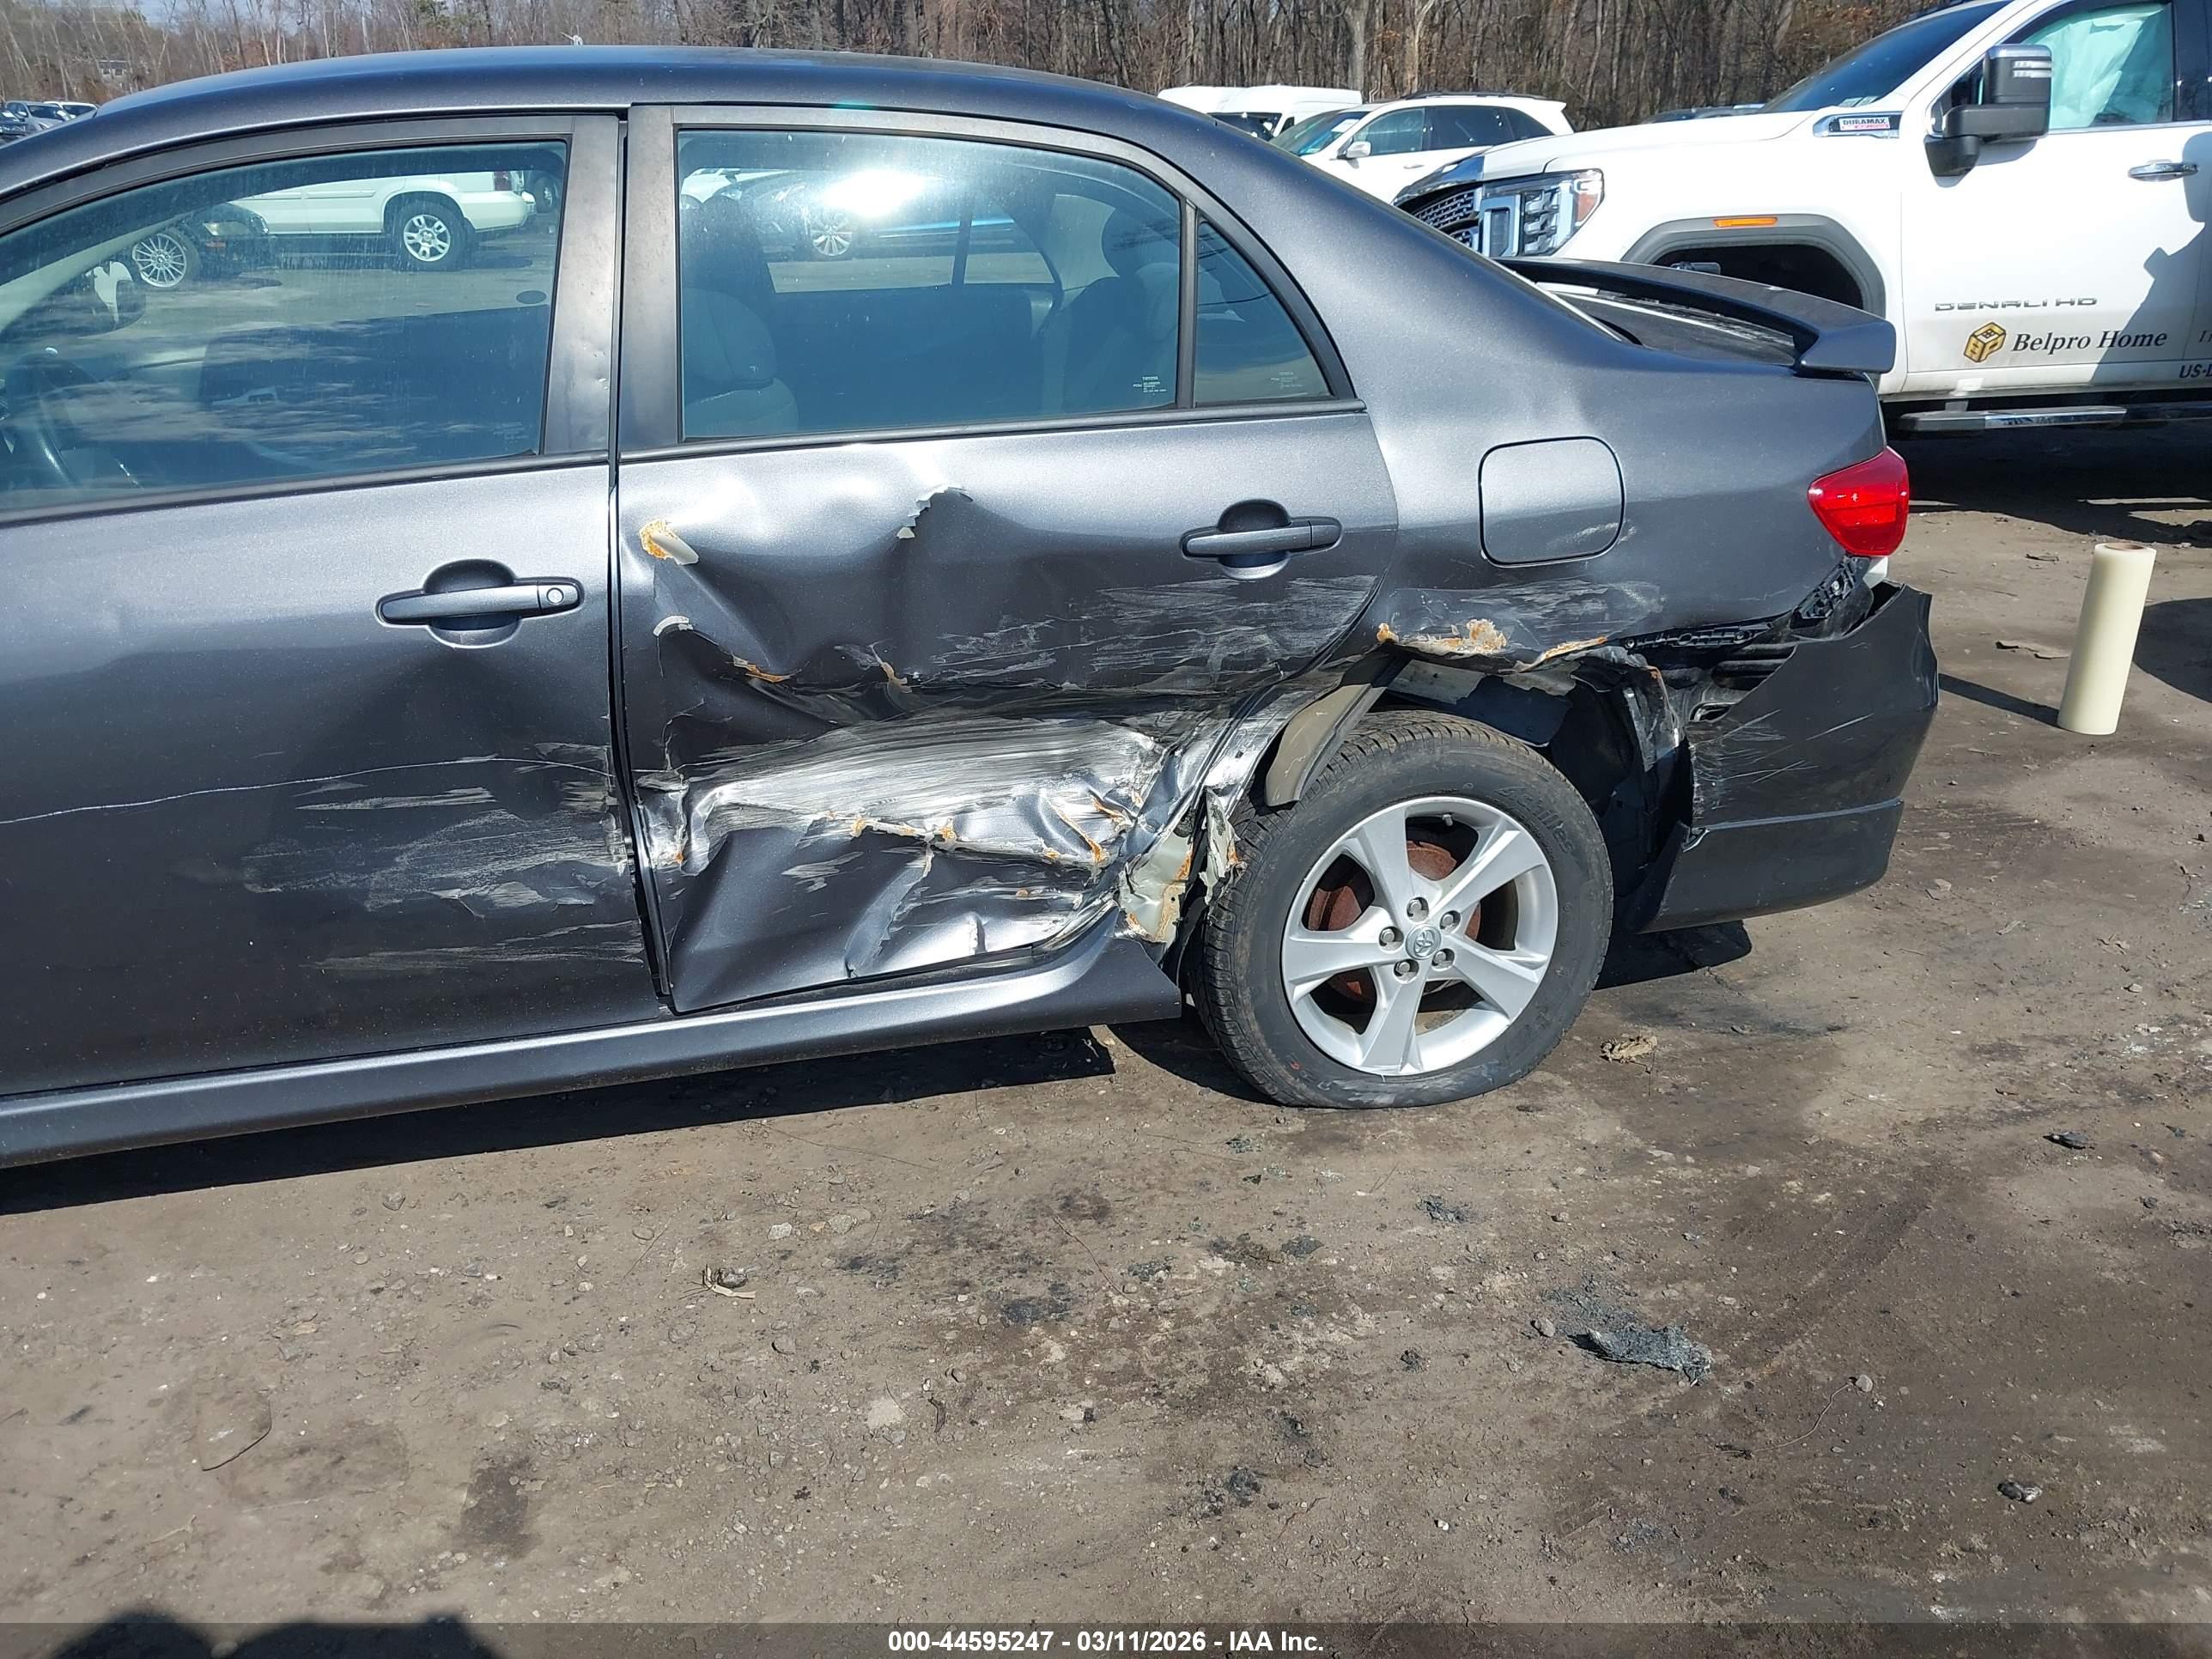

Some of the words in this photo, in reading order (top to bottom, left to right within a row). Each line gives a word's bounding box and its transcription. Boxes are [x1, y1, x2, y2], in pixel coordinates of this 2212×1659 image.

[1935, 299, 2047, 312] DENALI
[2055, 297, 2097, 307] HD
[2011, 332, 2091, 355] Belpro
[2097, 331, 2168, 348] Home
